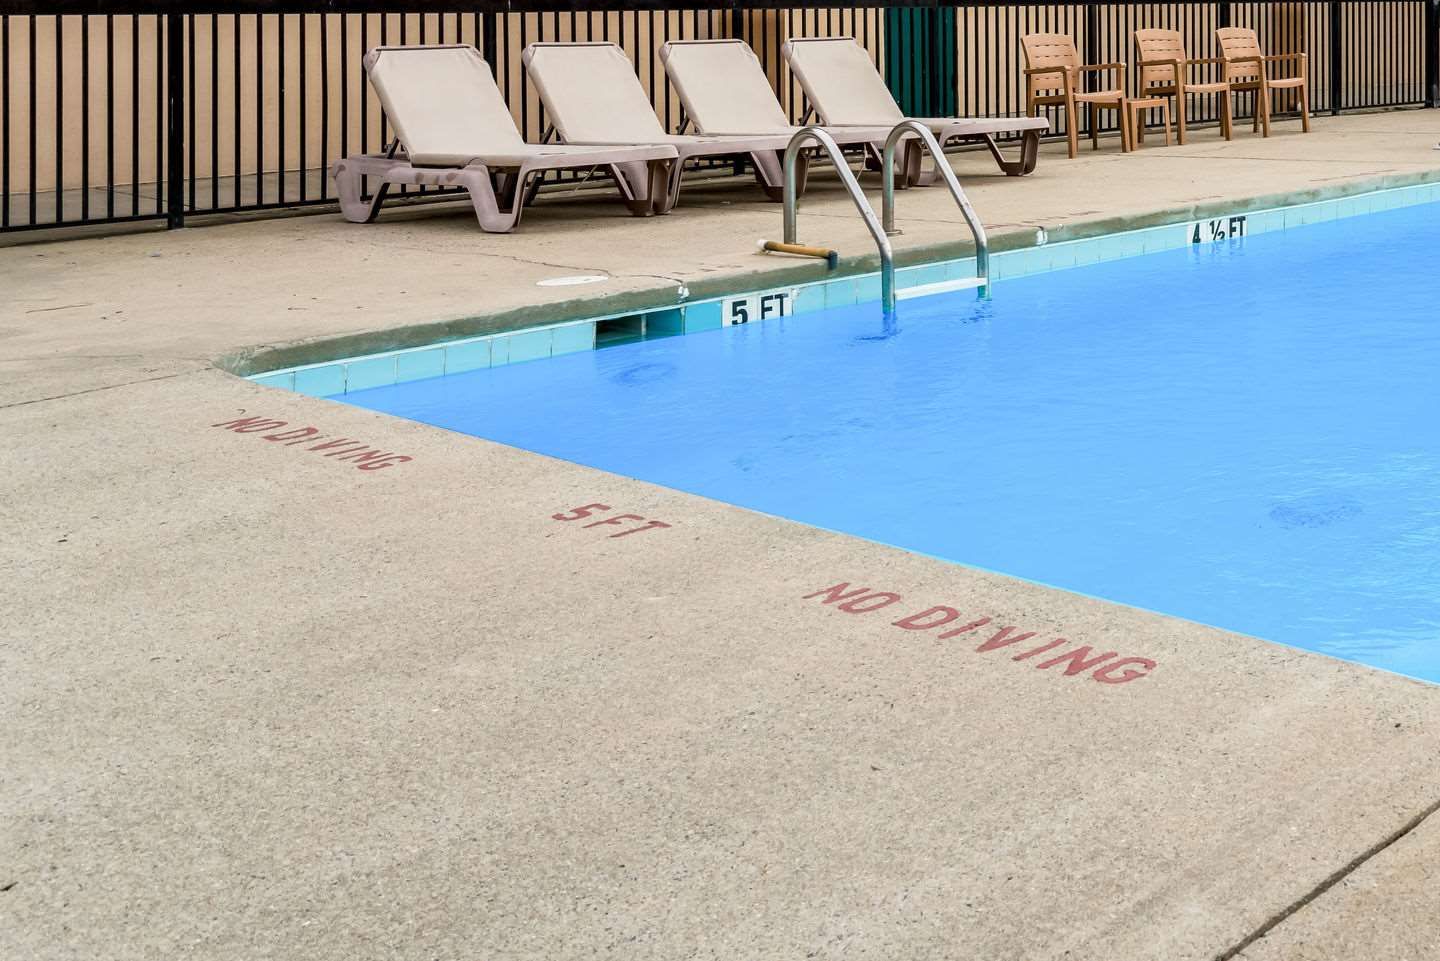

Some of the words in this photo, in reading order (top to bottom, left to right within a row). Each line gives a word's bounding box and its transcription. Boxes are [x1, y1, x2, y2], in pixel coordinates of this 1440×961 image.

[1192, 222, 1201, 243] 4
[1228, 216, 1246, 238] FT
[731, 300, 749, 326] 5
[760, 293, 789, 321] FT
[211, 415, 288, 434] NO
[268, 426, 413, 471] DIVING
[550, 502, 611, 522] 5
[581, 513, 672, 539] FT
[802, 581, 900, 614] NO
[891, 605, 1157, 685] DIVING
